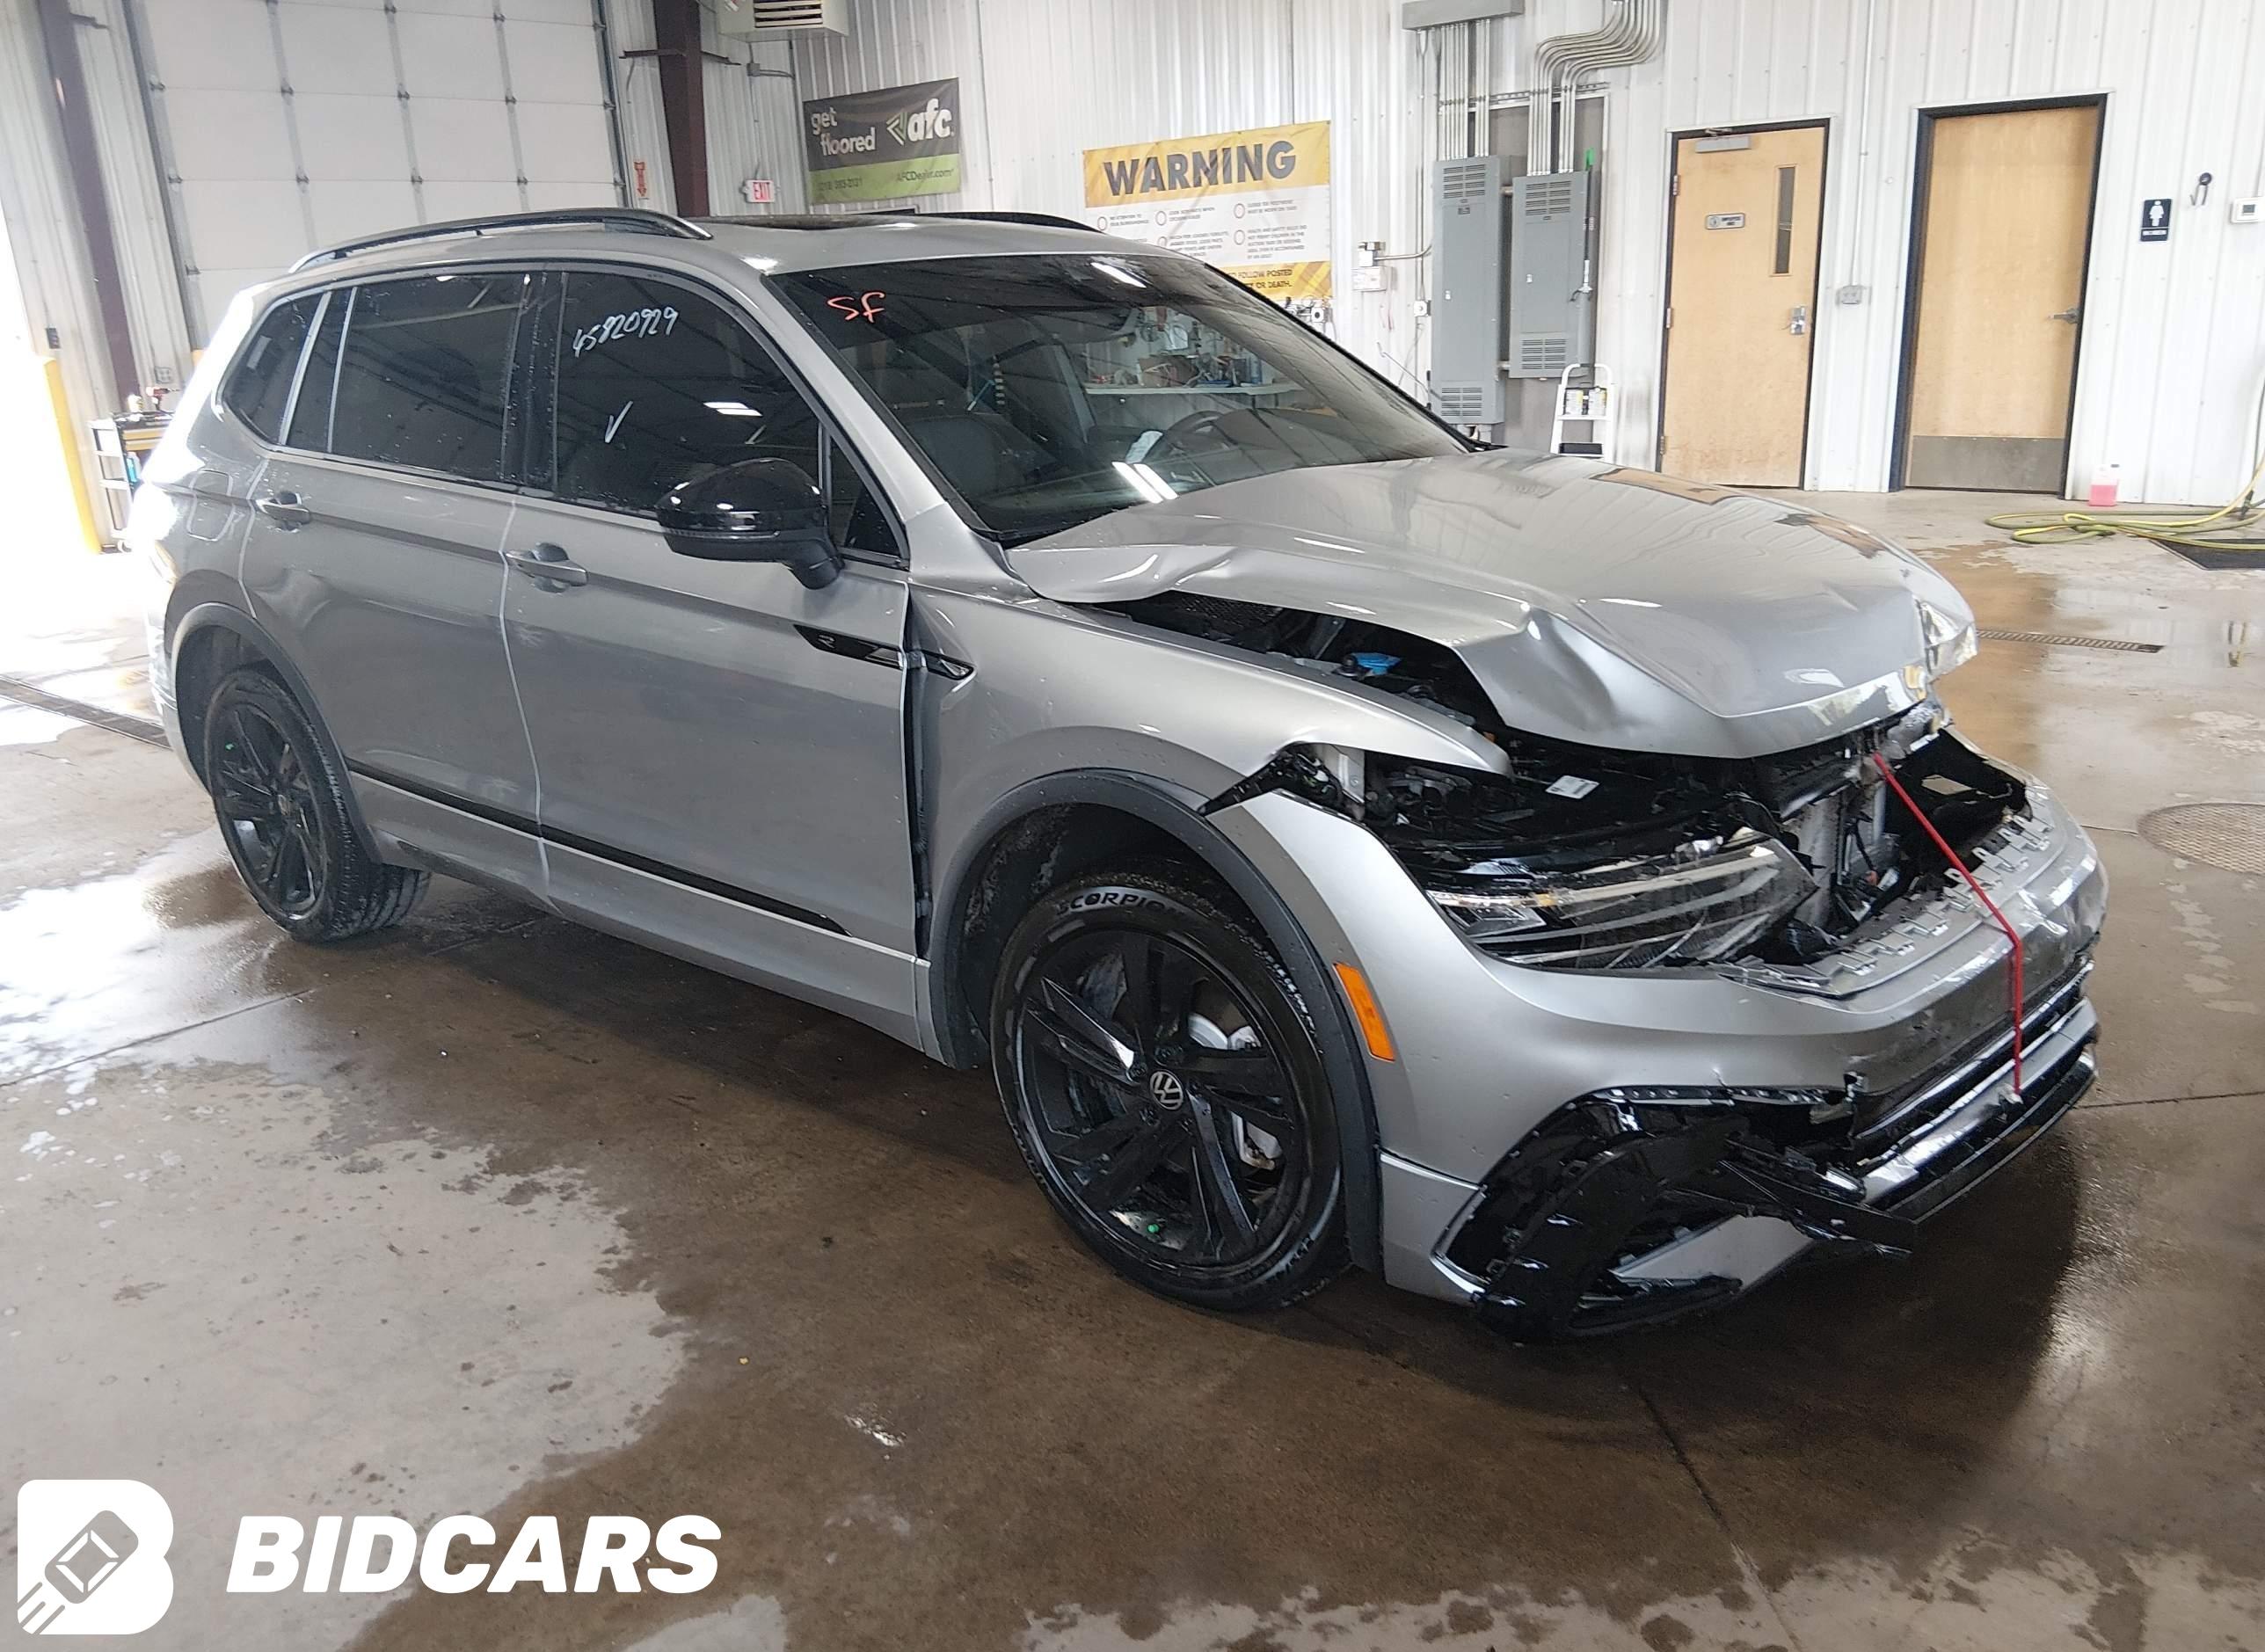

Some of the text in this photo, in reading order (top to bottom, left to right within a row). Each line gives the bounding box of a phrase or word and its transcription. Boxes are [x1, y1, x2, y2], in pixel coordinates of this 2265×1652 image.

[811, 107, 837, 135] get
[907, 98, 952, 142] afc
[820, 127, 876, 156] floored
[1103, 141, 1297, 196] WARNING
[753, 181, 770, 200] EXIT
[1238, 270, 1265, 279] FOLLOW
[1266, 268, 1293, 277] POSTED
